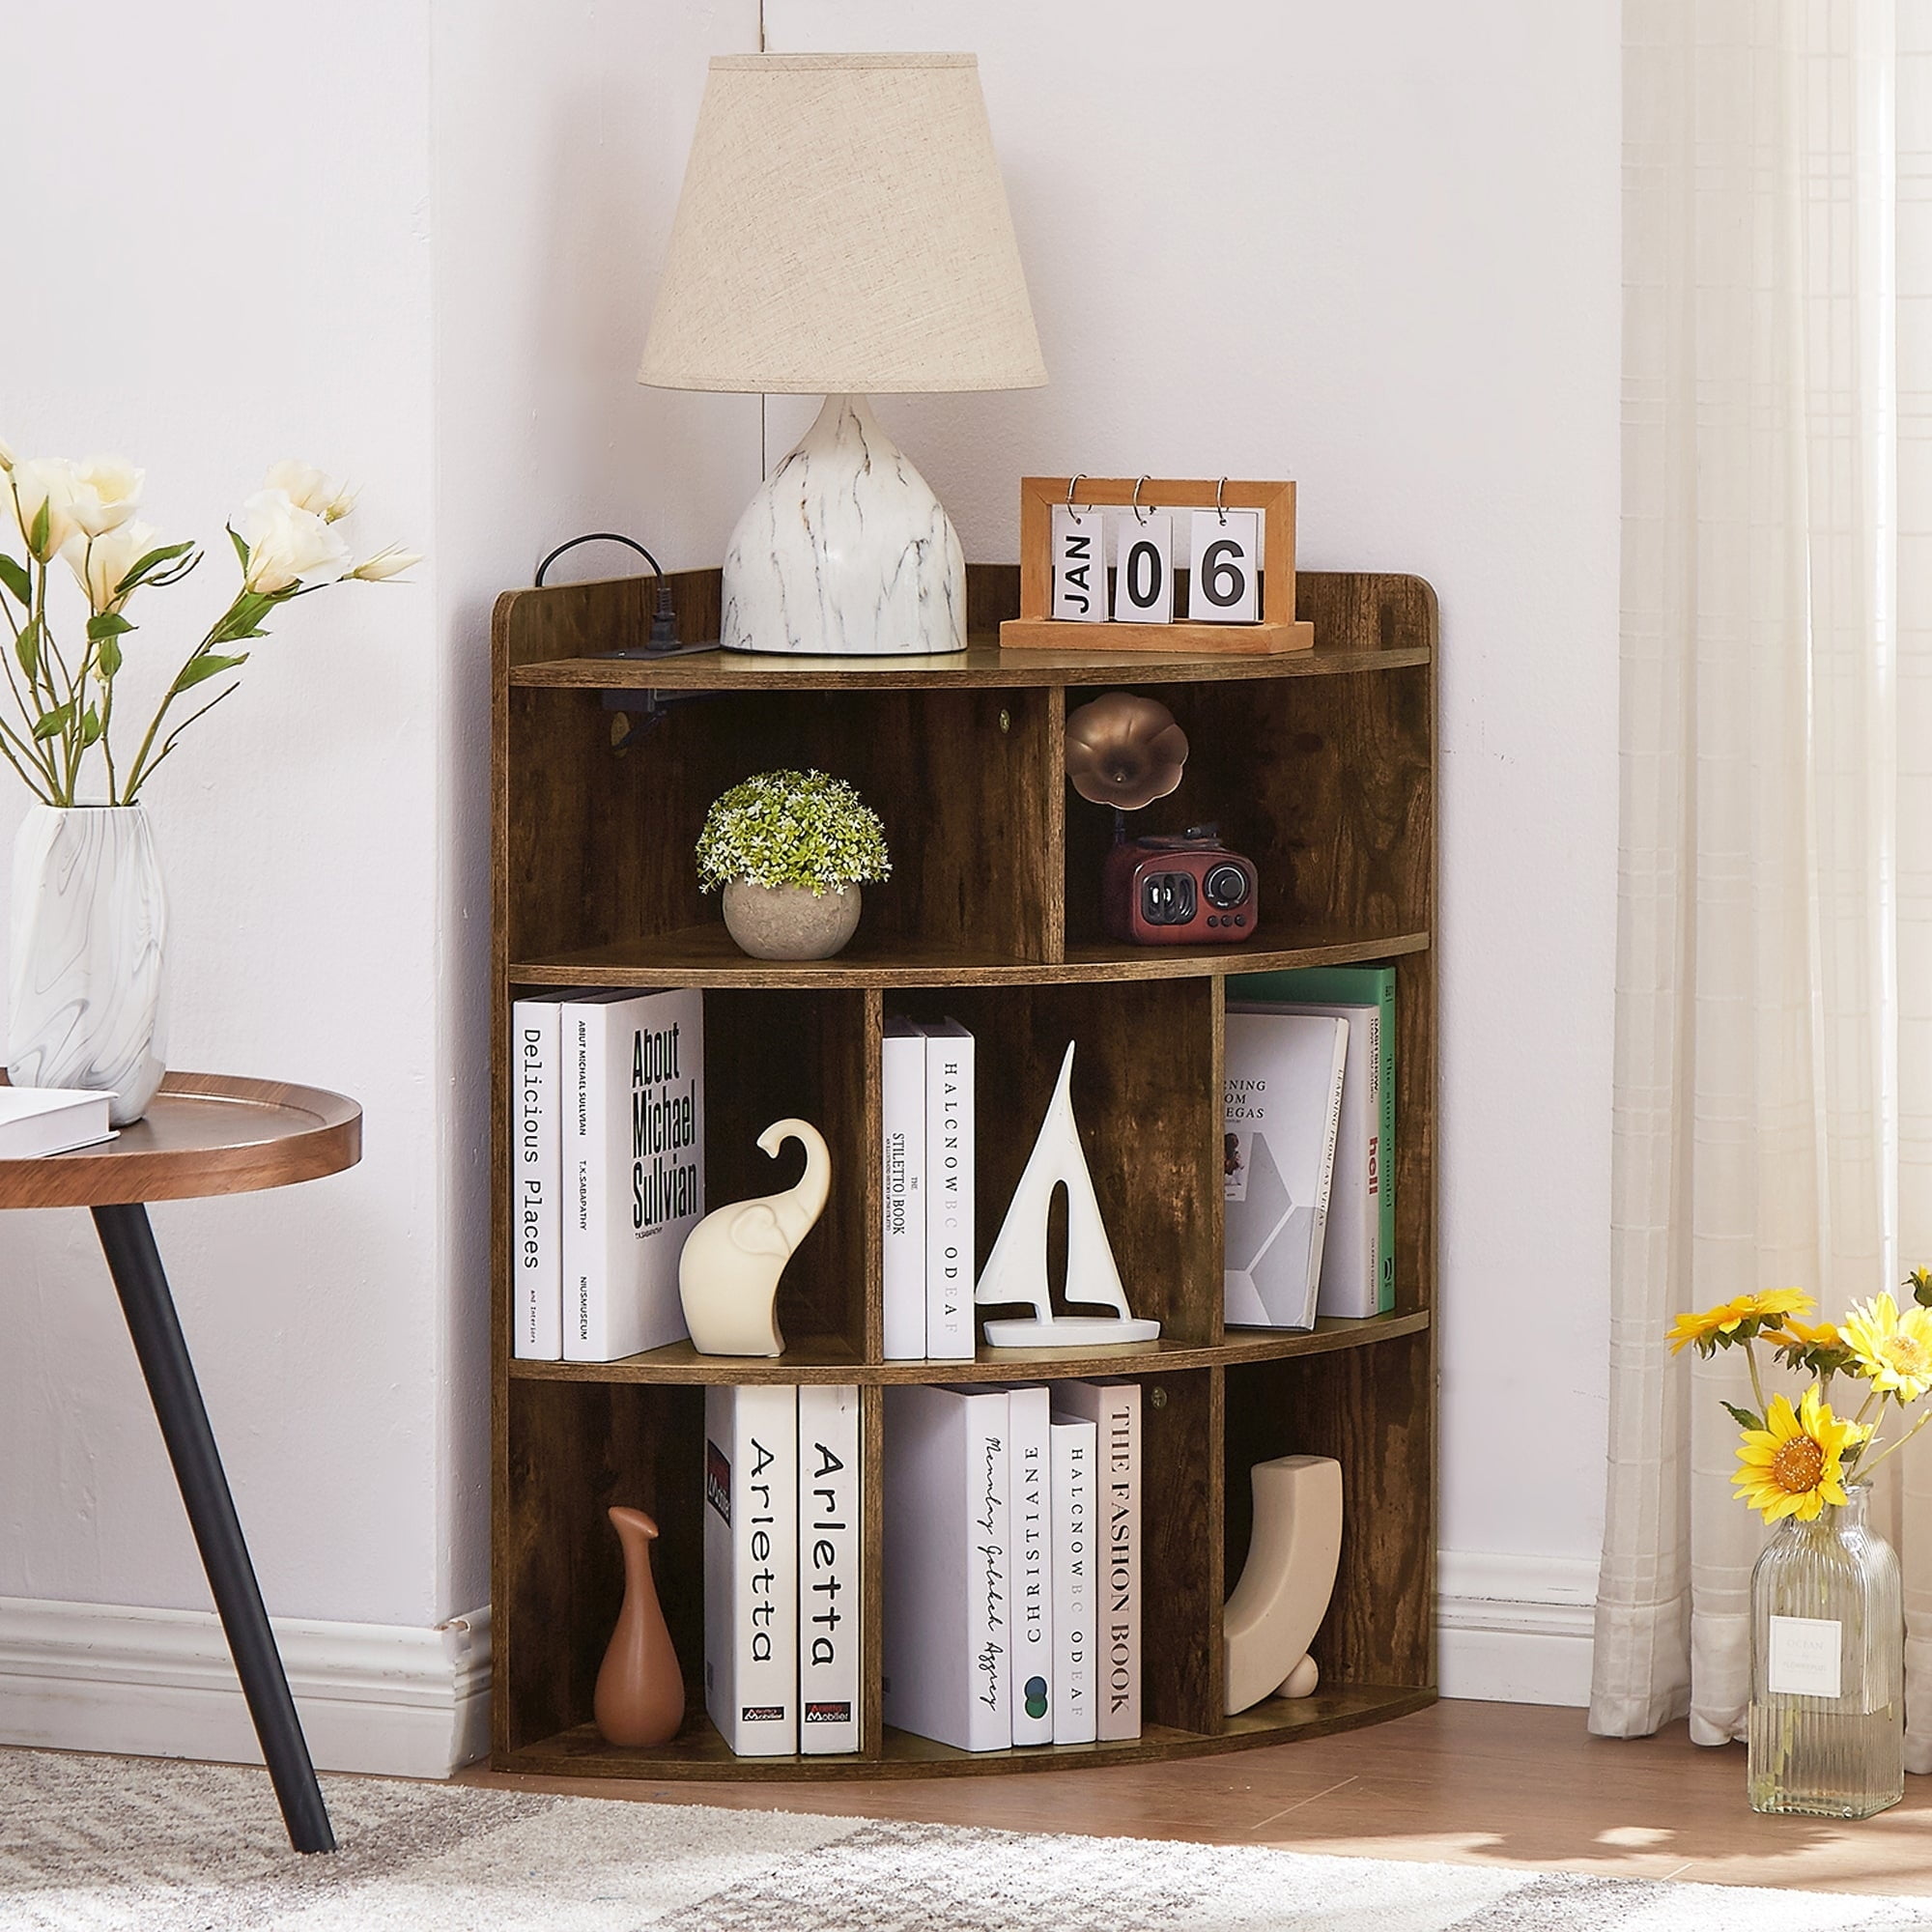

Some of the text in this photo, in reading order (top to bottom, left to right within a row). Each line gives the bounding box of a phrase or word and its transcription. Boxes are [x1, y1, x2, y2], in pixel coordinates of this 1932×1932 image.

[1064, 534, 1091, 614] JAN
[1201, 539, 1246, 608] 6
[524, 1029, 543, 1163] Delicious
[579, 1050, 587, 1090] MICHAEL
[633, 1022, 679, 1088] About
[1225, 1080, 1266, 1091] NING
[633, 1079, 696, 1158] Michael
[1226, 1108, 1264, 1119] EGAS
[524, 1179, 543, 1268] Places
[892, 1132, 905, 1235] STILETTO BOOK
[751, 1437, 775, 1662] Arletta
[811, 1442, 846, 1667] Arletta
[1025, 1447, 1041, 1643] CHRISTIANE
[1111, 1406, 1130, 1715] THE FASHION BOOK
